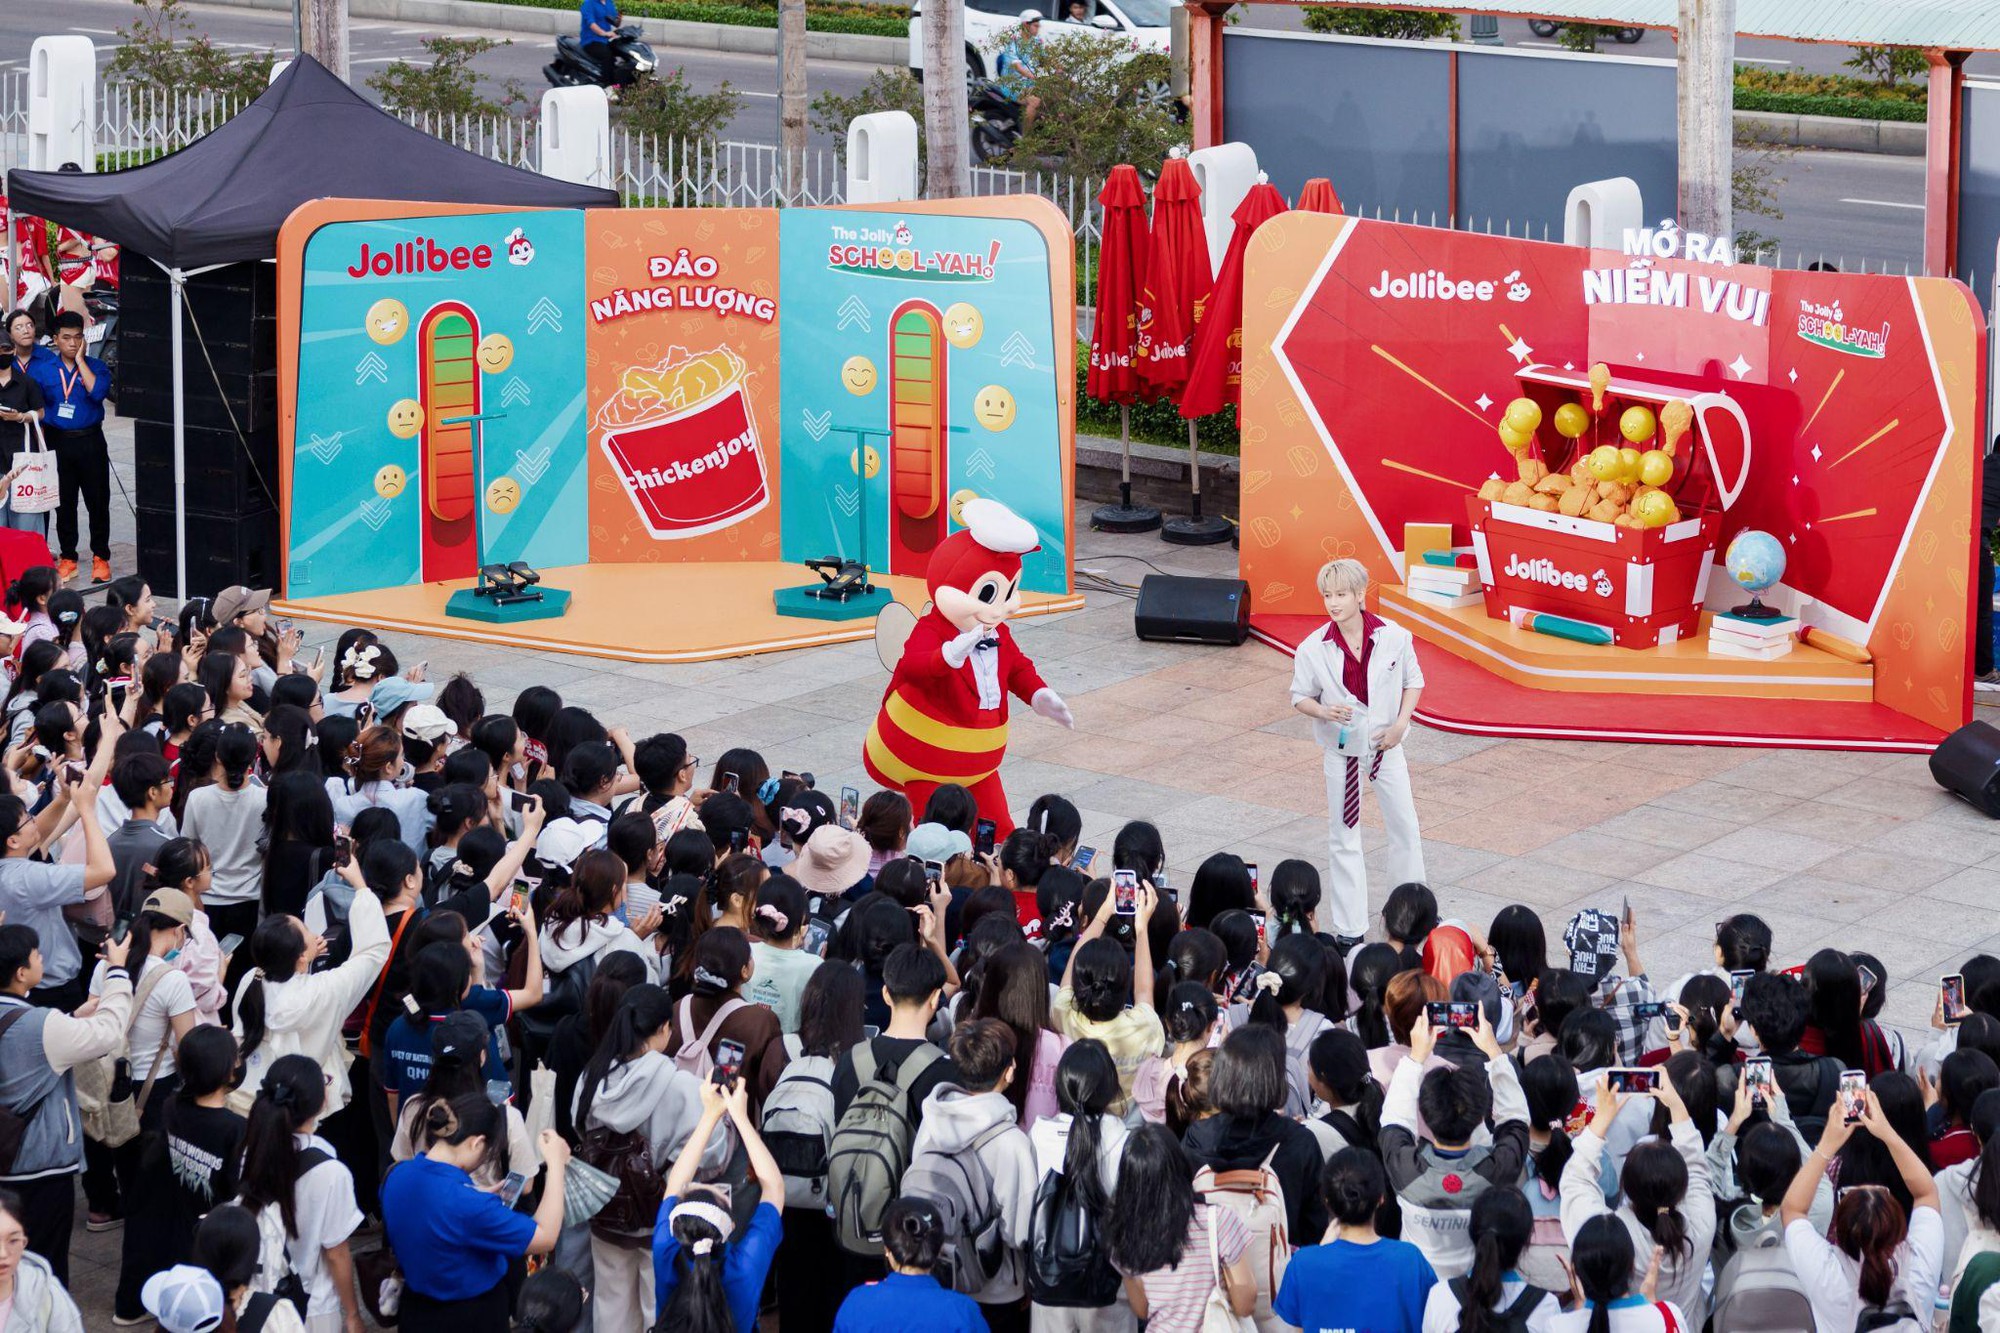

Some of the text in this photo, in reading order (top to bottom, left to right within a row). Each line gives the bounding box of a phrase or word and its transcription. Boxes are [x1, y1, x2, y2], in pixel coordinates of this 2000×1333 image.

[831, 226, 894, 245] The Jolly
[1623, 218, 1734, 267] MỞ RA
[347, 236, 493, 279] Jollibee
[648, 248, 718, 279] ĐẢO
[1369, 269, 1495, 301] Jollibee
[1698, 275, 1771, 328] VUI
[591, 285, 776, 322] NĂNG LƯỢNG
[1799, 299, 1834, 320] The Jolly
[626, 427, 757, 492] chickenjoy
[17, 484, 34, 497] 20
[1504, 553, 1589, 593] Jollibee
[1573, 962, 1596, 975] FAN
